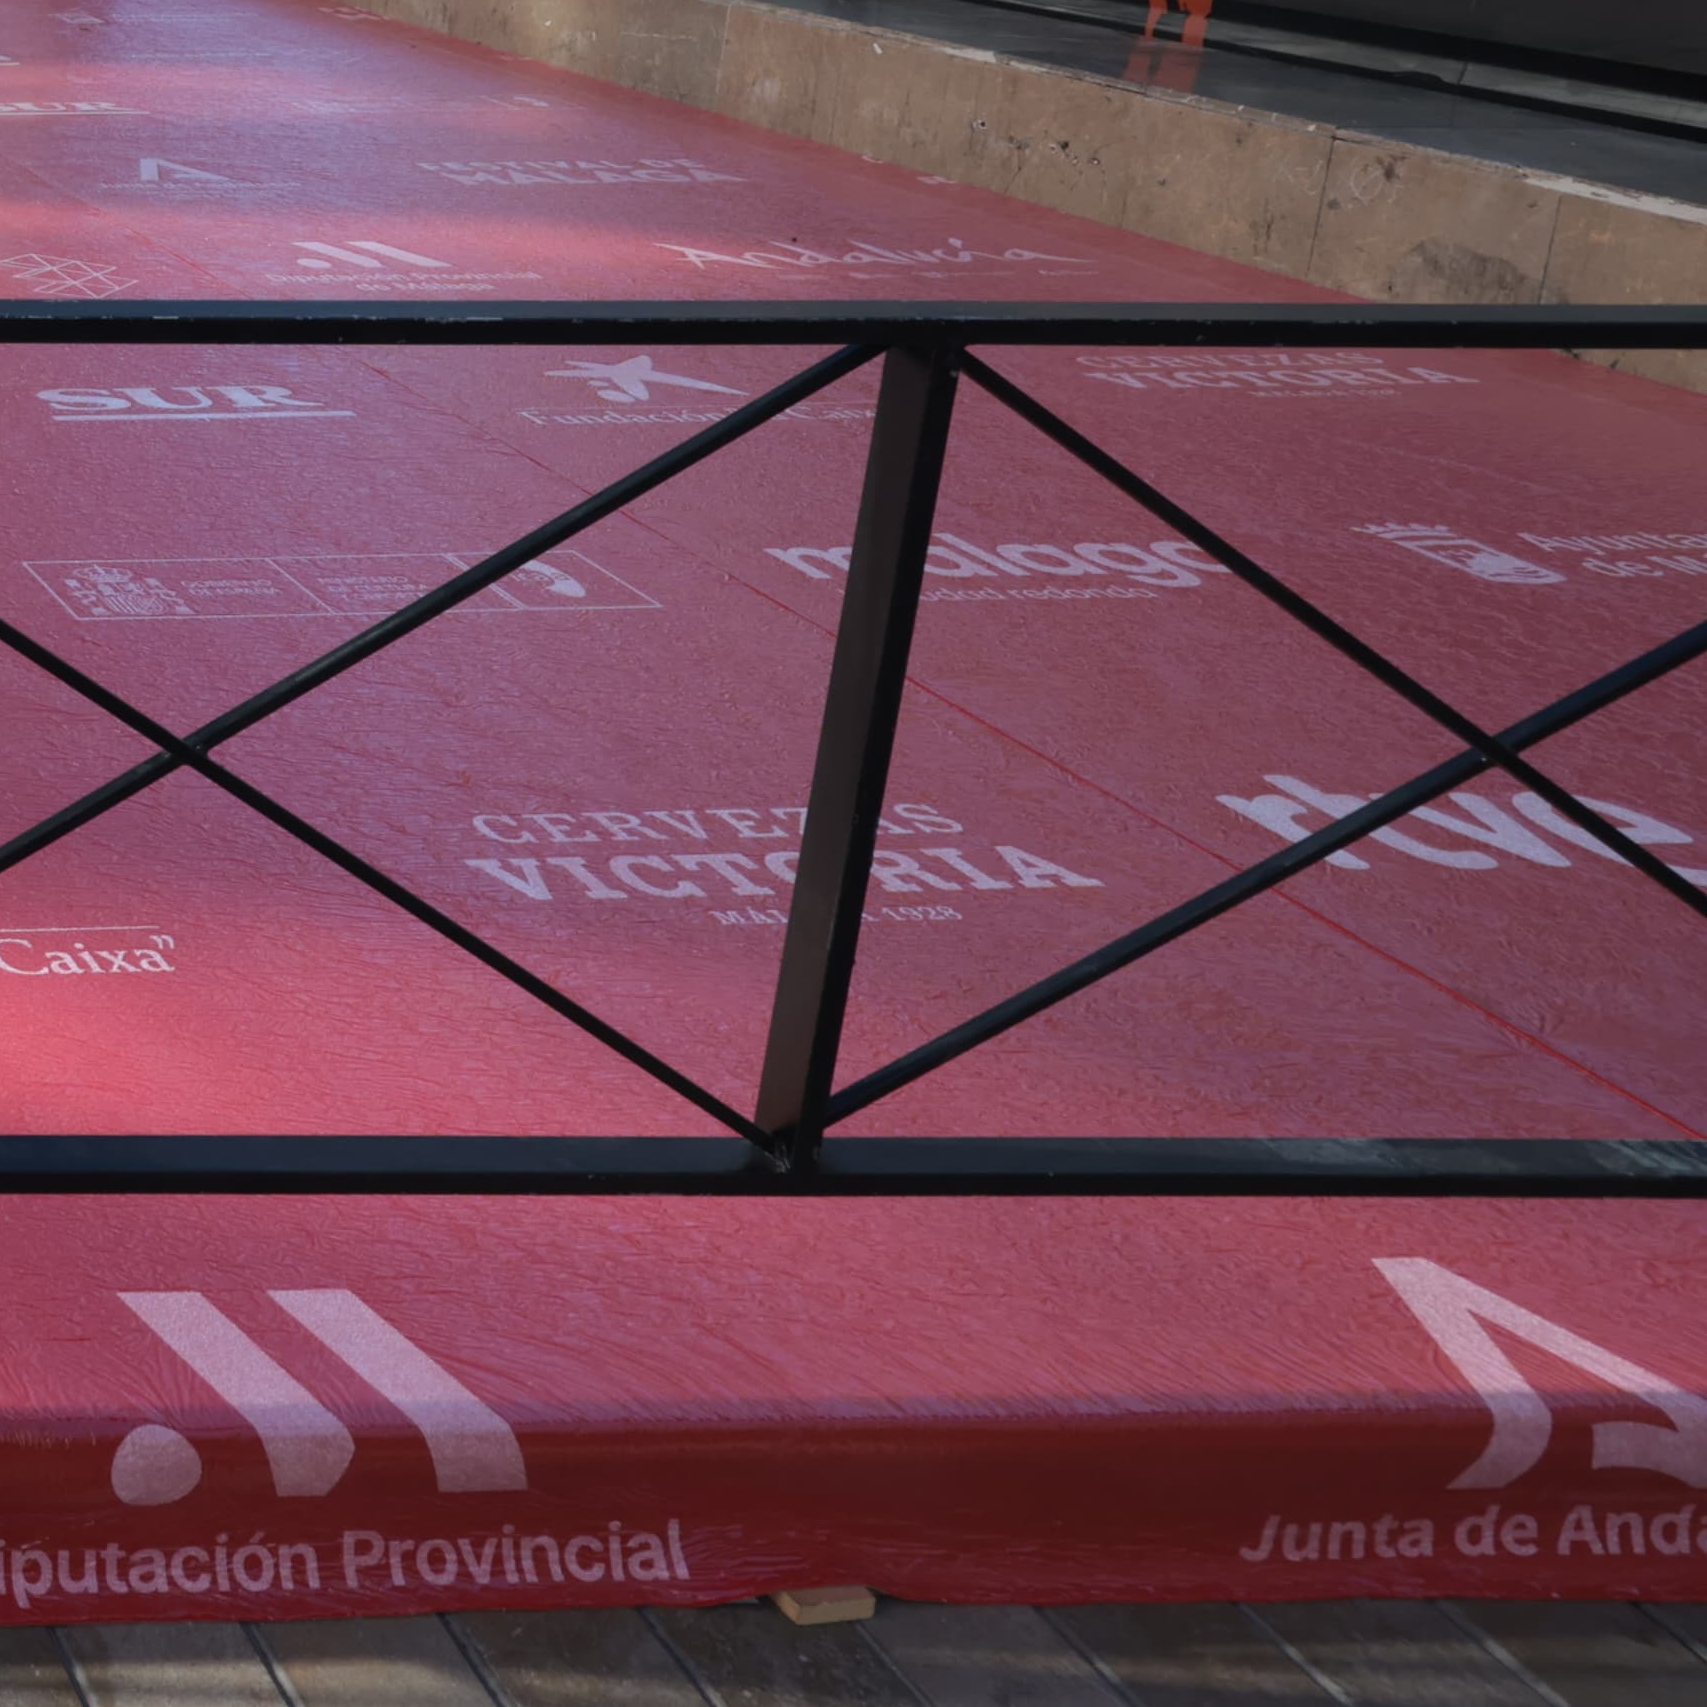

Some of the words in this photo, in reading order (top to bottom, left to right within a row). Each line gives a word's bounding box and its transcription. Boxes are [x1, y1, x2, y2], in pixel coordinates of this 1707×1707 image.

[415, 160, 633, 171] FESTIVAL
[640, 158, 707, 168] DE
[650, 237, 1100, 271] Andalucía
[1075, 352, 1386, 369] CERVEZAS
[1086, 367, 1483, 390] VICTORIA
[35, 384, 325, 411] SUR
[471, 803, 965, 844] CERVES
[879, 905, 965, 923] 1928
[1238, 1511, 1435, 1564] Junta
[1453, 1502, 1540, 1558] de
[342, 1519, 690, 1591] Provincial
